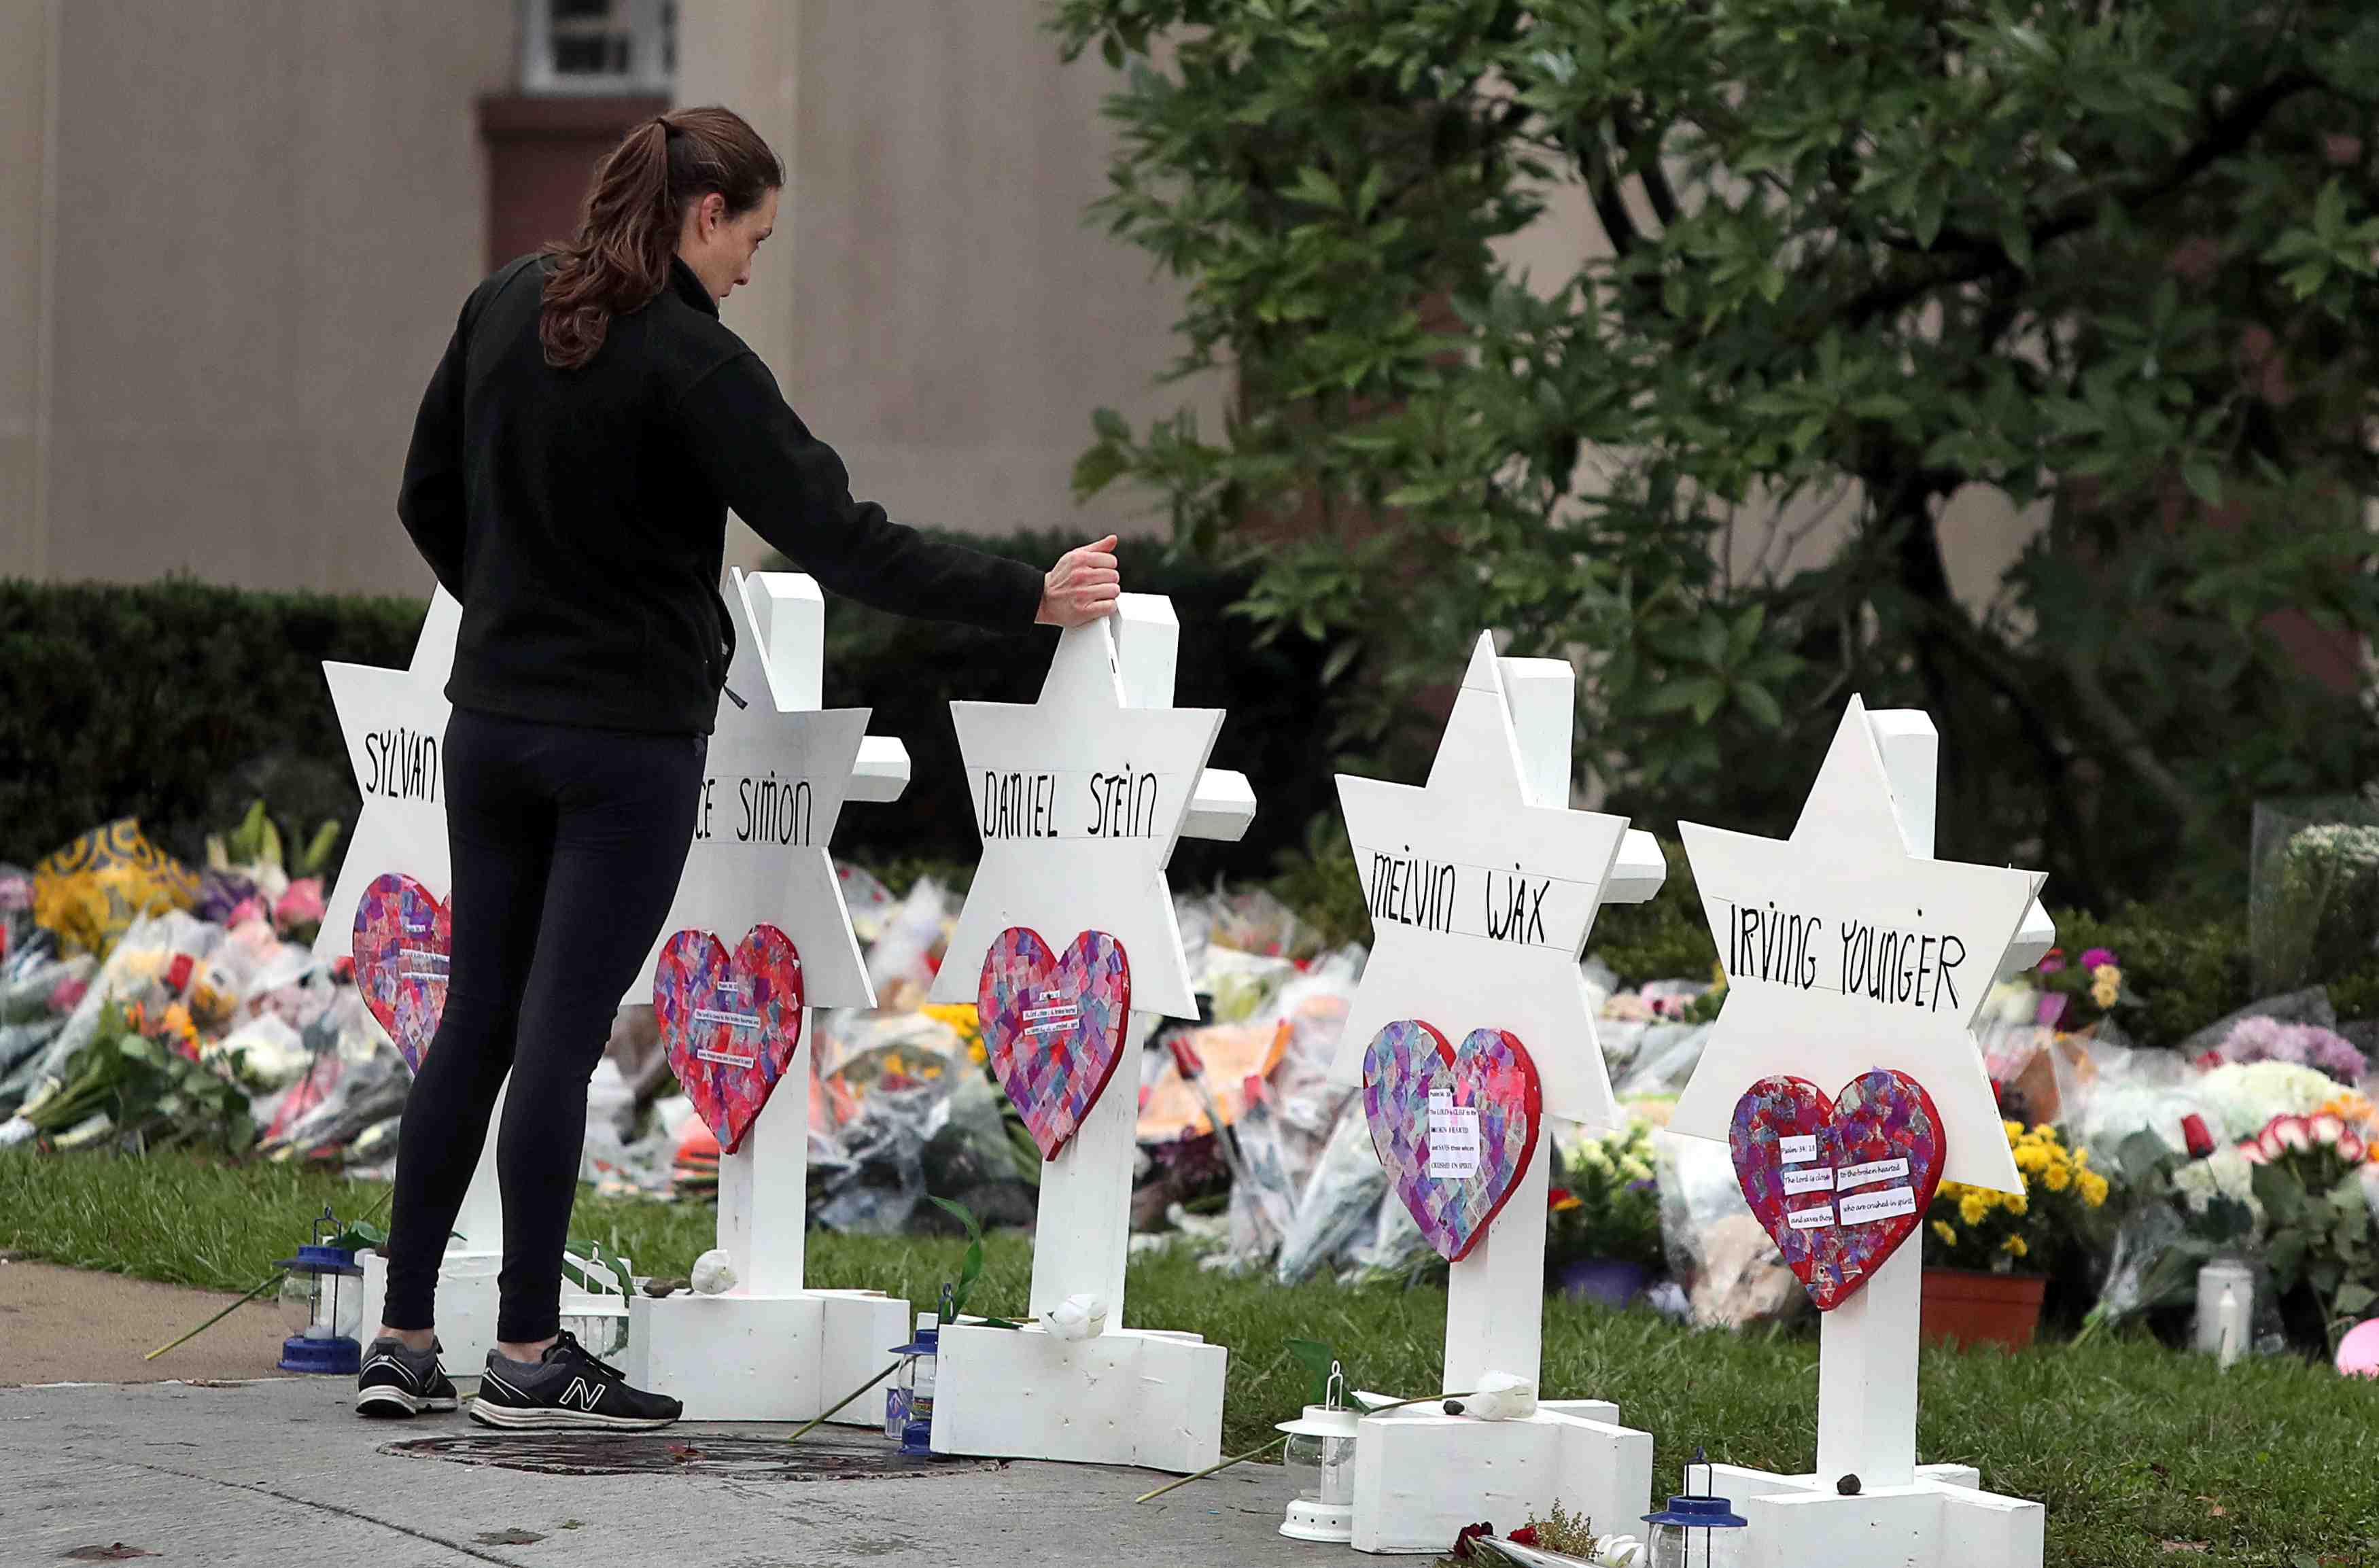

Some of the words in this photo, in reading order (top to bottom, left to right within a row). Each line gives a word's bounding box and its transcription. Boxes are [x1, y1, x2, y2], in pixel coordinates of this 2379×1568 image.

[365, 727, 438, 803] SYLVAN
[984, 771, 1058, 840] DANIEL
[1088, 763, 1157, 839] STEIN
[736, 770, 812, 848] SIMON
[1370, 844, 1455, 935] MELVIN
[1486, 863, 1550, 945] WAX
[1730, 901, 1822, 990] IRVING
[1841, 909, 1966, 1013] YOUNGER
